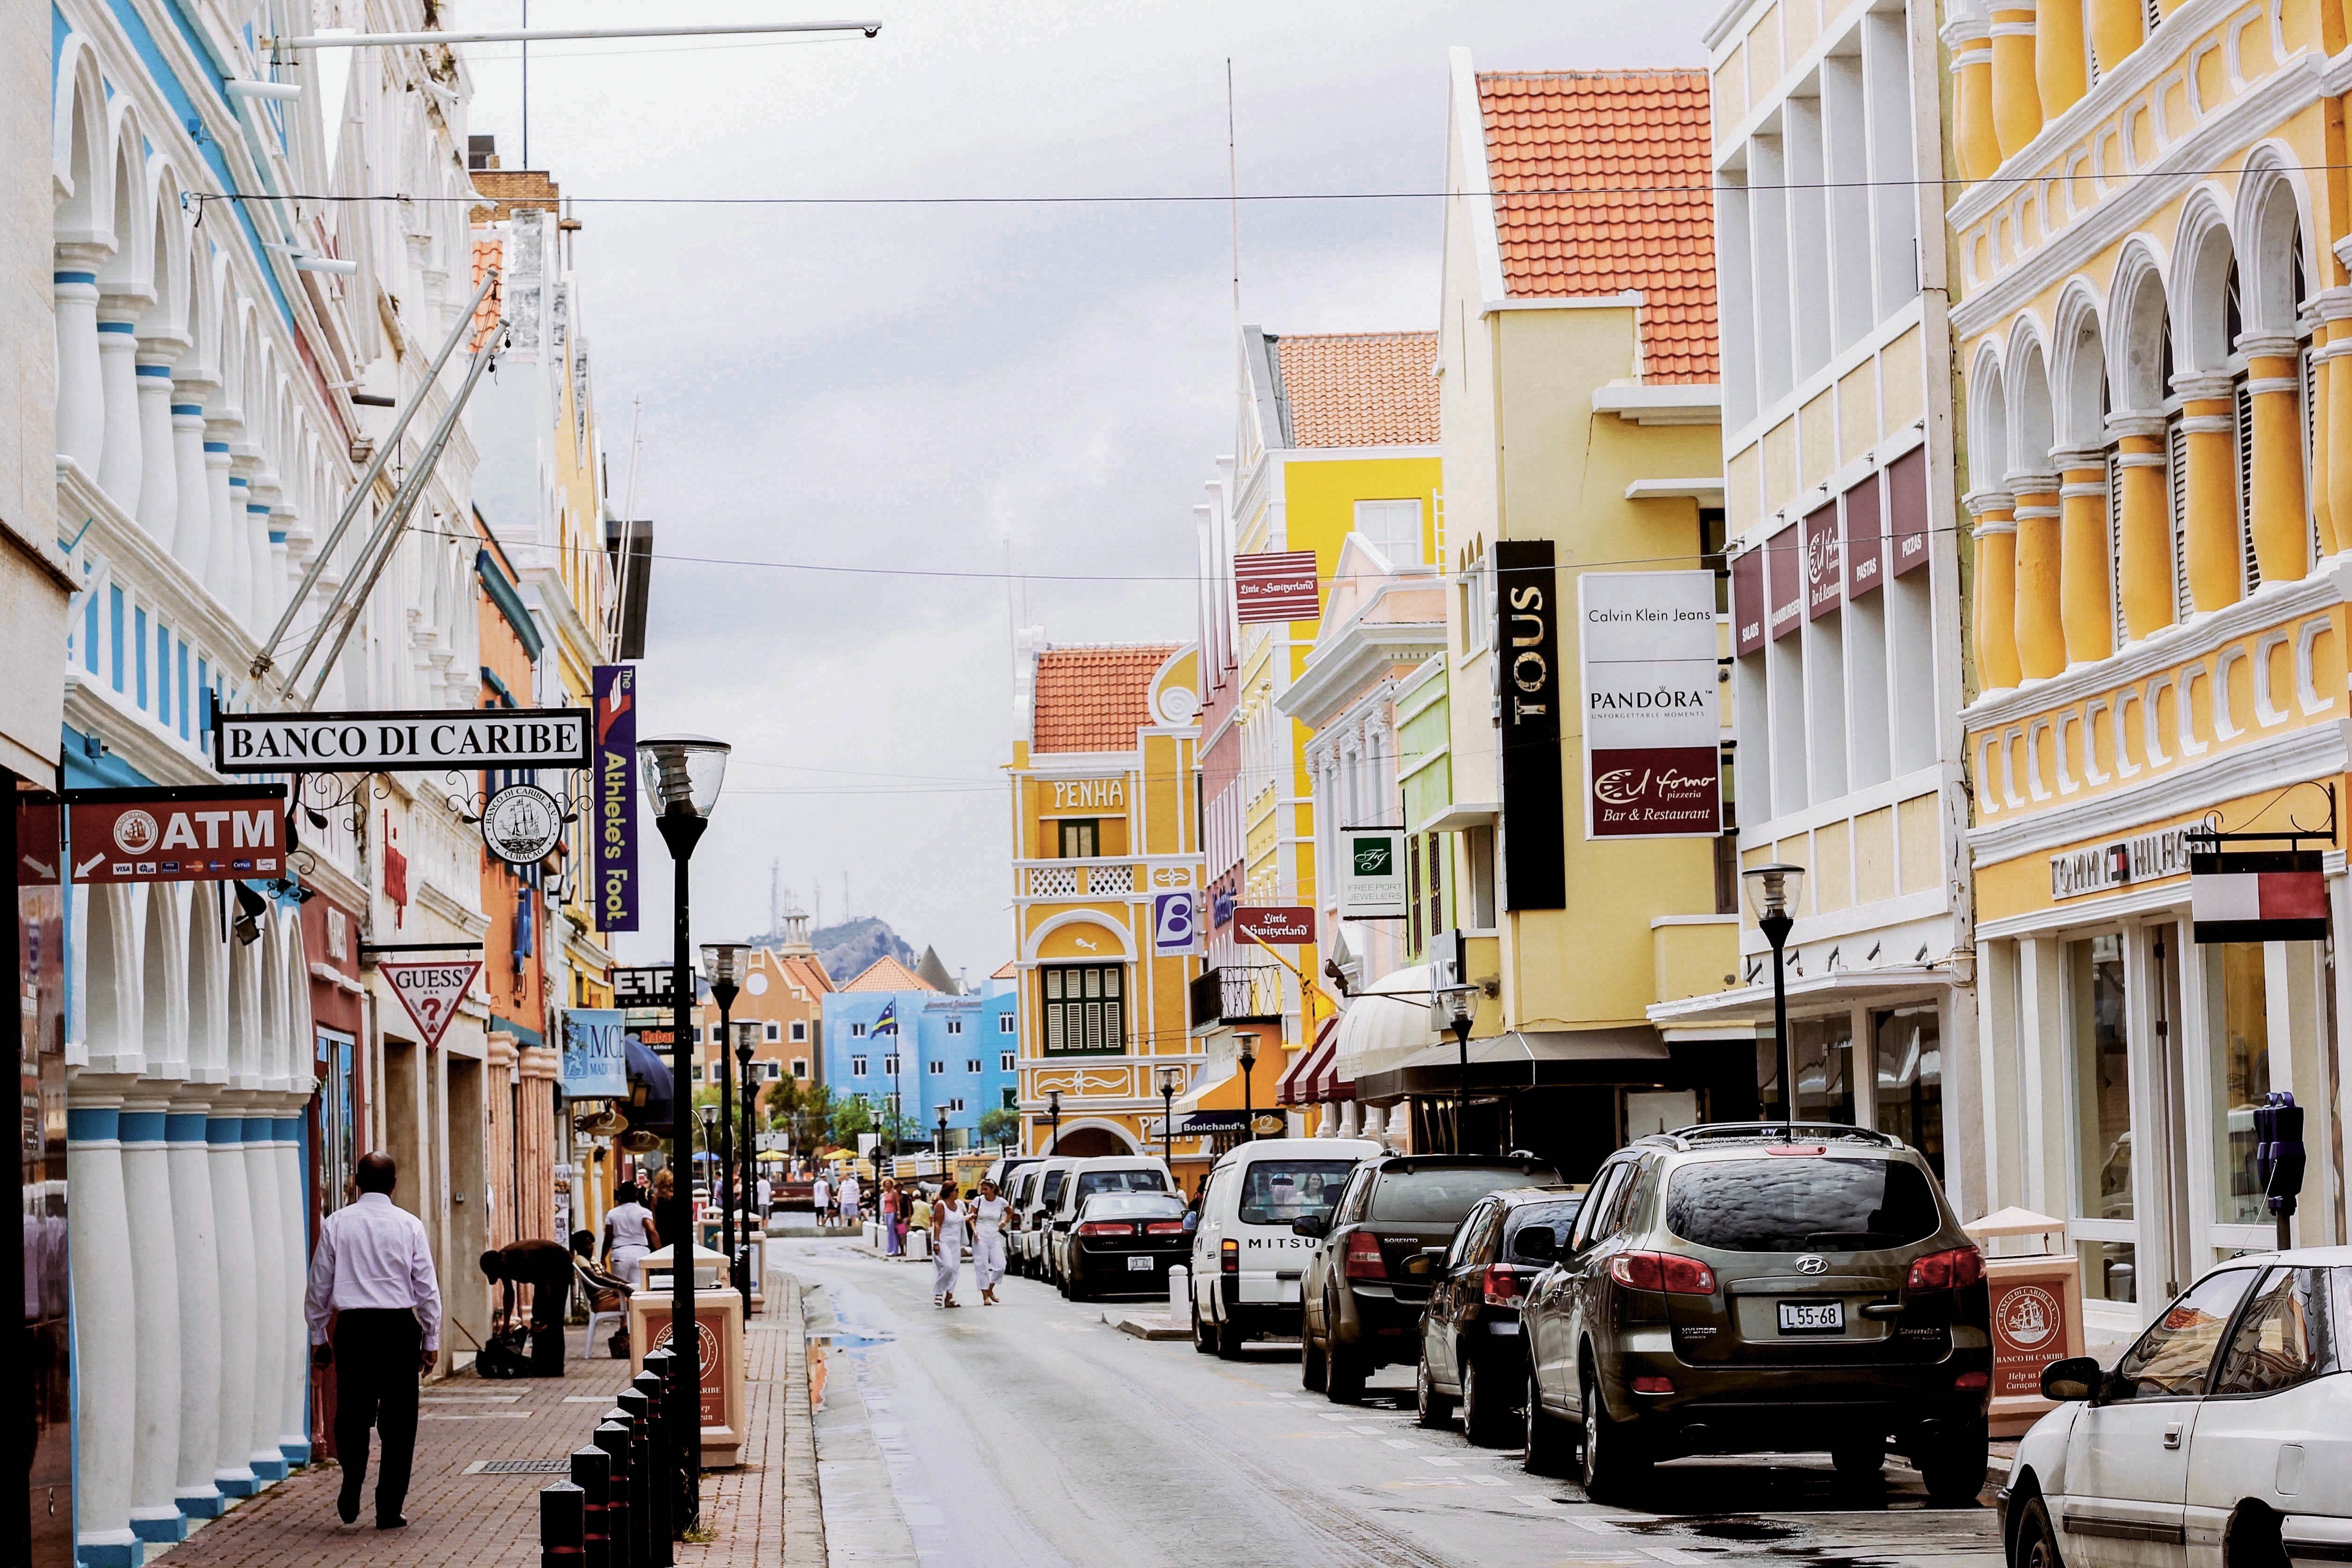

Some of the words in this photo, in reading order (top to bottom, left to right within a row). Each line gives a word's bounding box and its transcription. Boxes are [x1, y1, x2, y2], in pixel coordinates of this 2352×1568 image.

[1902, 533, 1922, 558] PIZZAS
[1856, 557, 1877, 582] PASTAS
[1240, 584, 1260, 594] Little
[1261, 580, 1314, 594] Switzerland
[1589, 609, 1632, 622] Calvin
[1636, 609, 1668, 621] Klein
[1673, 609, 1710, 621] Jeans
[1742, 622, 1759, 642] SALADS
[1510, 587, 1546, 725] TOUS
[622, 669, 632, 689] The
[1591, 691, 1703, 709] PANDORA
[230, 727, 367, 758] BANCO
[378, 726, 419, 755] DI
[430, 724, 578, 755] CARIBE
[1054, 780, 1123, 808] PENHA
[1667, 790, 1701, 800] pizzeria
[486, 797, 503, 824] BANCO
[504, 789, 514, 798] DI
[516, 788, 547, 803] CARIBE
[545, 802, 557, 819] N.V.
[604, 751, 627, 859] Athlete's
[1603, 809, 1626, 821] Bar
[1629, 808, 1640, 820] &
[1643, 808, 1710, 820] Restaurant
[160, 810, 275, 850] ATM
[505, 848, 544, 861] CURAÇAO
[2049, 847, 2110, 894] TOMMY
[605, 869, 628, 922] Foot
[1348, 892, 1402, 900] JEWELERS
[1156, 895, 1192, 942] B
[1263, 913, 1287, 924] Little
[1248, 924, 1308, 938] Switzerland
[396, 969, 463, 989] GUESS
[1183, 1122, 1245, 1132] Boolchand's
[1998, 1295, 2014, 1317] BANCO
[2024, 1289, 2049, 1301] CARIBE
[1786, 1308, 1794, 1325] L
[1797, 1308, 1836, 1325] 55-68
[655, 1327, 672, 1350] BANCO
[1996, 1355, 2024, 1364] BANCO
[2009, 1372, 2026, 1381] Help
